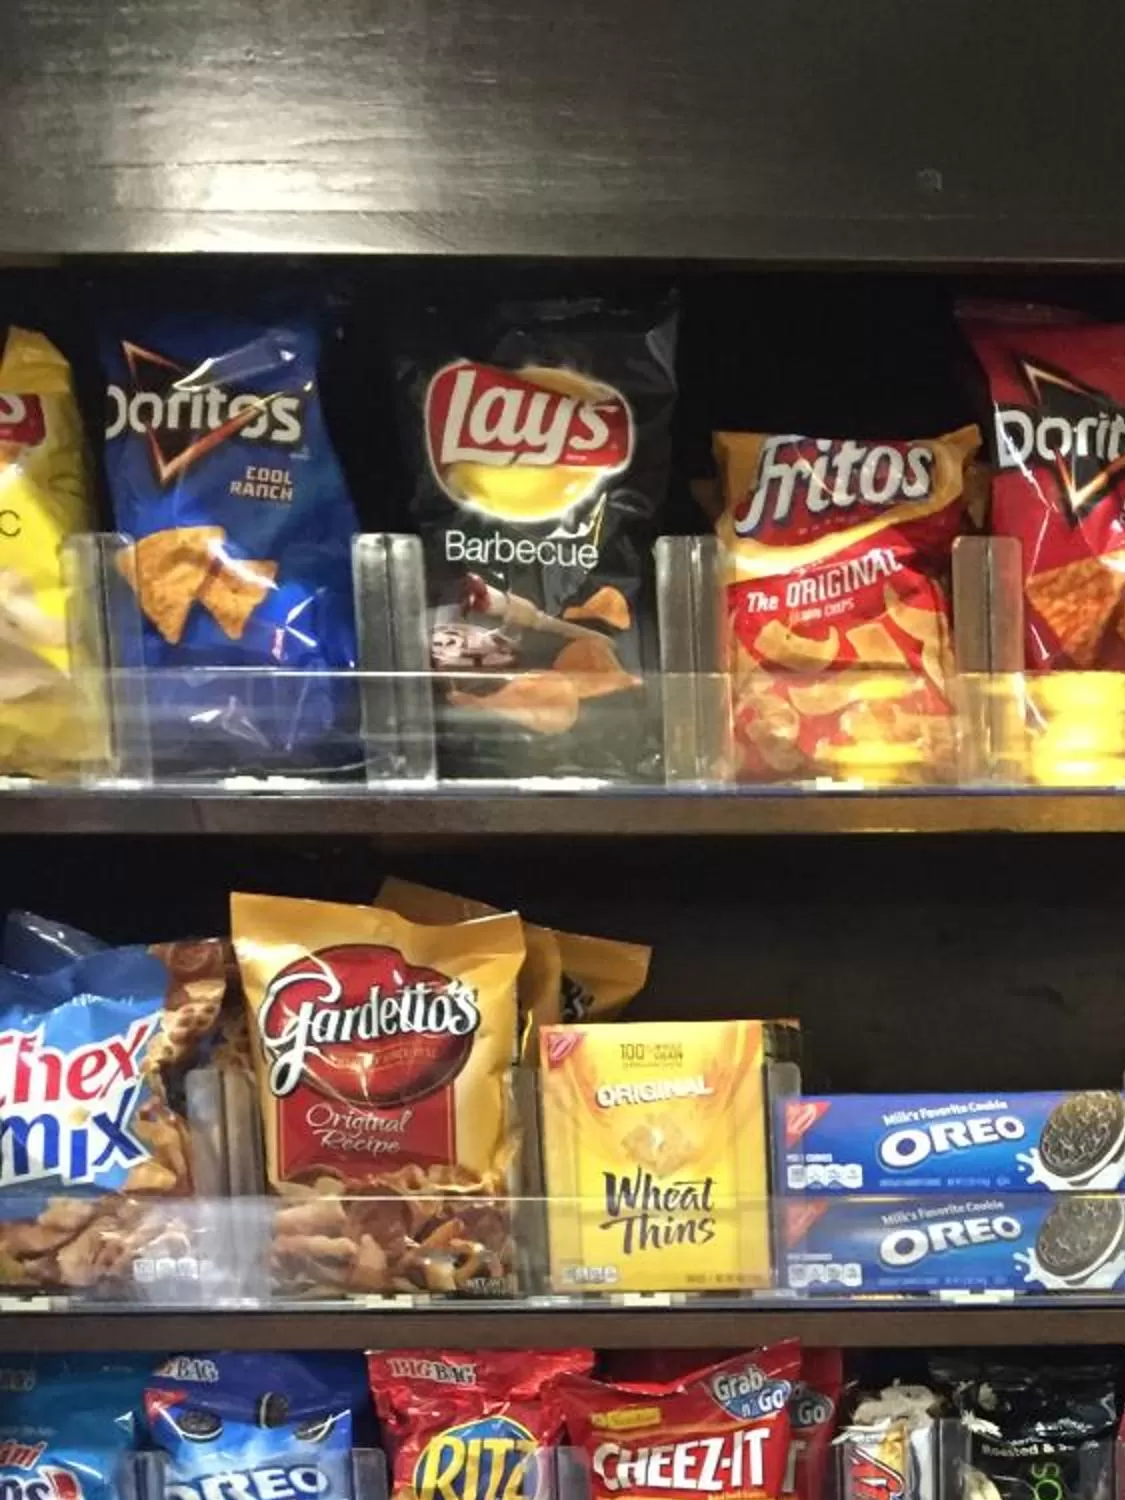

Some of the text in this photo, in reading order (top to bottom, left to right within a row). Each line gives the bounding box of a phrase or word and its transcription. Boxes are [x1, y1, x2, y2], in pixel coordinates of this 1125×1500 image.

[230, 482, 293, 501] RANCH
[246, 466, 293, 485] COOL
[737, 434, 934, 532] Fritos
[445, 530, 599, 569] Barbecue
[747, 548, 903, 613] The ORIGINAL
[259, 972, 480, 1096] Gardetto's
[0, 1022, 149, 1101] hex
[597, 1074, 713, 1108] ORIGINAL
[306, 1102, 413, 1138] Original
[919, 1104, 966, 1118] Favorite
[312, 1129, 400, 1157] Recipe
[880, 1116, 1025, 1168] OREO
[603, 1167, 714, 1212] Wheat
[601, 1213, 716, 1253] Thins
[880, 1216, 1021, 1266] OREO
[388, 1359, 477, 1387] BIG BAG
[713, 1364, 764, 1401] Grab
[758, 1389, 784, 1412] Go
[798, 1401, 826, 1425] Go
[593, 1427, 771, 1491] CHEEZ-IT
